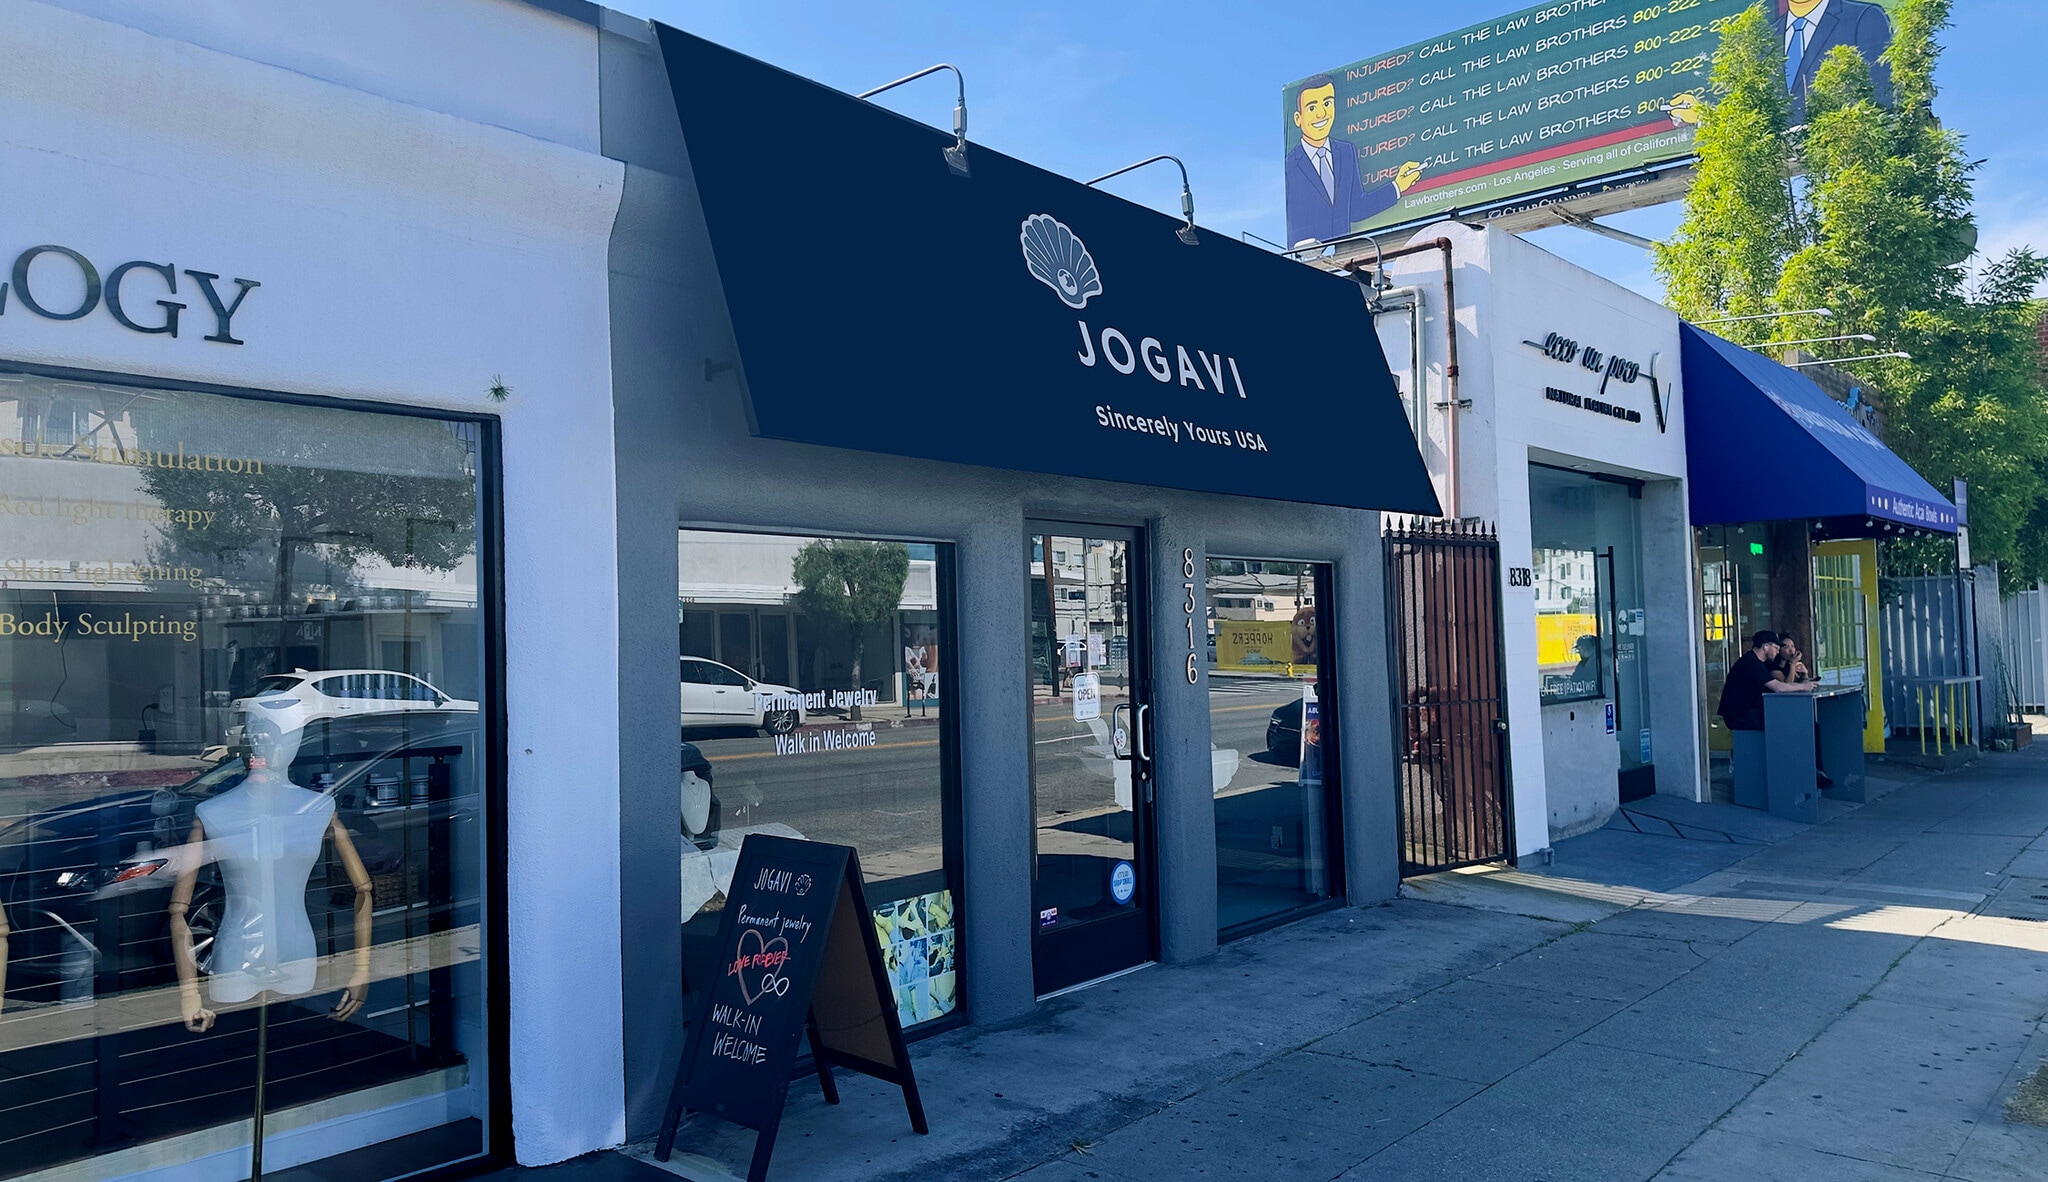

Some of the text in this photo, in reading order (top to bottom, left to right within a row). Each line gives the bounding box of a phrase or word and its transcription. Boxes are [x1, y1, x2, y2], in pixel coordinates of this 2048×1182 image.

[1345, 51, 1415, 82] INJURED?
[1418, 39, 1456, 60] CALL
[1461, 26, 1492, 46] THE
[1495, 16, 1530, 37] LAW
[1345, 78, 1415, 108] INJURED?
[1418, 66, 1457, 87] CALL
[1461, 54, 1492, 74] THE
[1495, 43, 1530, 64] LAW
[1535, 15, 1628, 53] BROTHERS
[1346, 105, 1416, 135] INJURED?
[1419, 94, 1458, 114] CALL
[1462, 82, 1492, 102] THE
[1496, 71, 1531, 93] LAW
[1536, 44, 1629, 82] BROTHERS
[1420, 122, 1458, 142] CALL
[1463, 111, 1493, 131] THE
[1497, 101, 1532, 121] LAW
[1537, 75, 1630, 111] BROTHERS
[1422, 150, 1460, 170] CALL
[1464, 140, 1494, 158] THE
[1499, 129, 1534, 151] LAW
[1538, 105, 1632, 140] BROTHERS
[1403, 132, 1689, 209] Lawbrothers.com Los Angeles Serving all of California
[0, 244, 262, 345] OGY
[1077, 319, 1248, 399] JOGAVI
[1095, 404, 1268, 452] Sincerely Yours USA
[75, 436, 264, 476] Stimulation
[54, 493, 114, 526] light
[125, 499, 217, 531] therapy
[1892, 496, 1915, 519] Authentic
[1925, 504, 1938, 524] Bowls
[3, 558, 204, 590] Skin tightening
[1509, 567, 1532, 588] 8318
[0, 611, 198, 643] Body Sculpting
[1183, 547, 1199, 686] 8316
[754, 688, 878, 713] Permanent Jewelry
[1077, 687, 1096, 702] OPEN
[774, 729, 876, 756] Walk in Welcome
[753, 867, 793, 894] JOGAVI
[737, 903, 813, 944] Permanent jewelry
[727, 954, 751, 977] LOVE
[711, 1003, 763, 1036] WALK-IN
[712, 1031, 768, 1065] WELCOME
